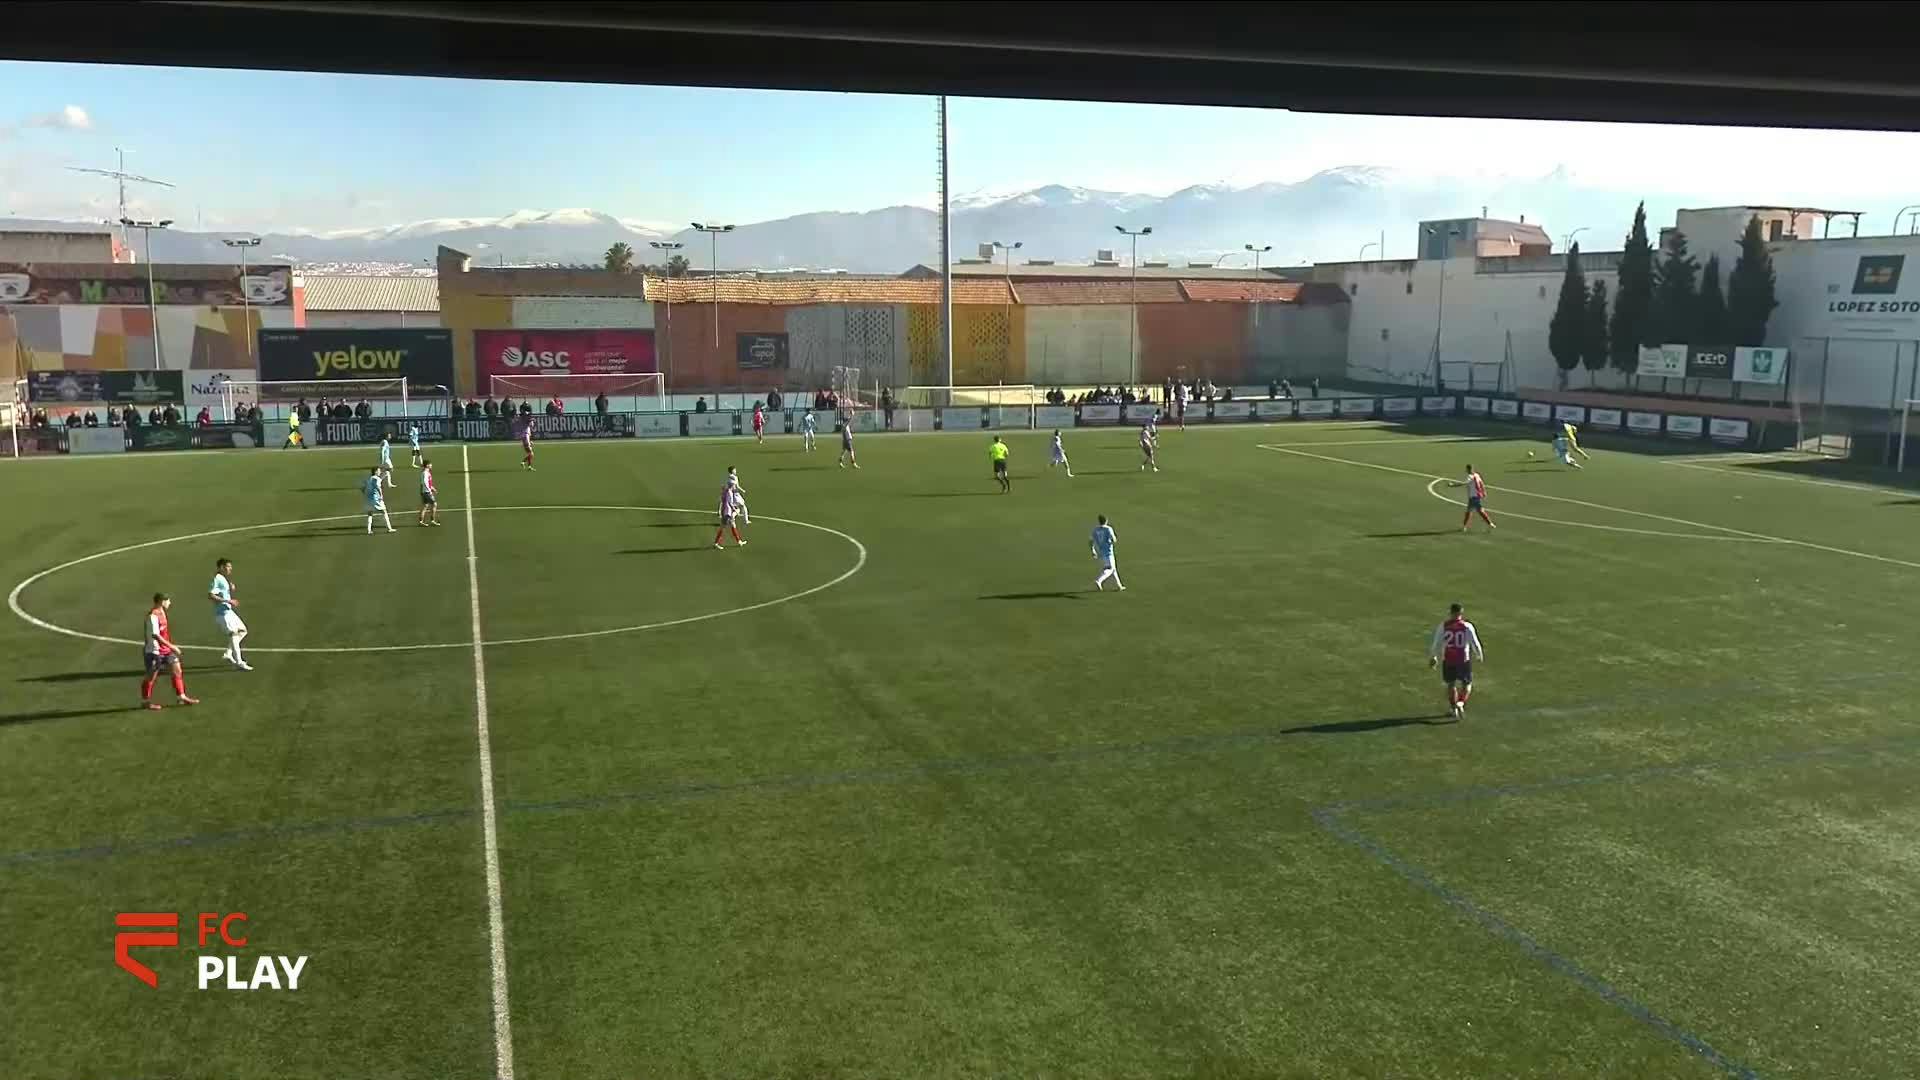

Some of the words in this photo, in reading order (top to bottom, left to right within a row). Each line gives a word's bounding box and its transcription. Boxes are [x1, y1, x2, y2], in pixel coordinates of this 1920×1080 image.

[1828, 301, 1876, 313] LOPEZ
[1879, 301, 1920, 313] SOTO
[313, 344, 401, 377] yelow
[523, 351, 571, 368] ASC
[457, 420, 490, 438] FUTUR
[1445, 631, 1465, 648] 20
